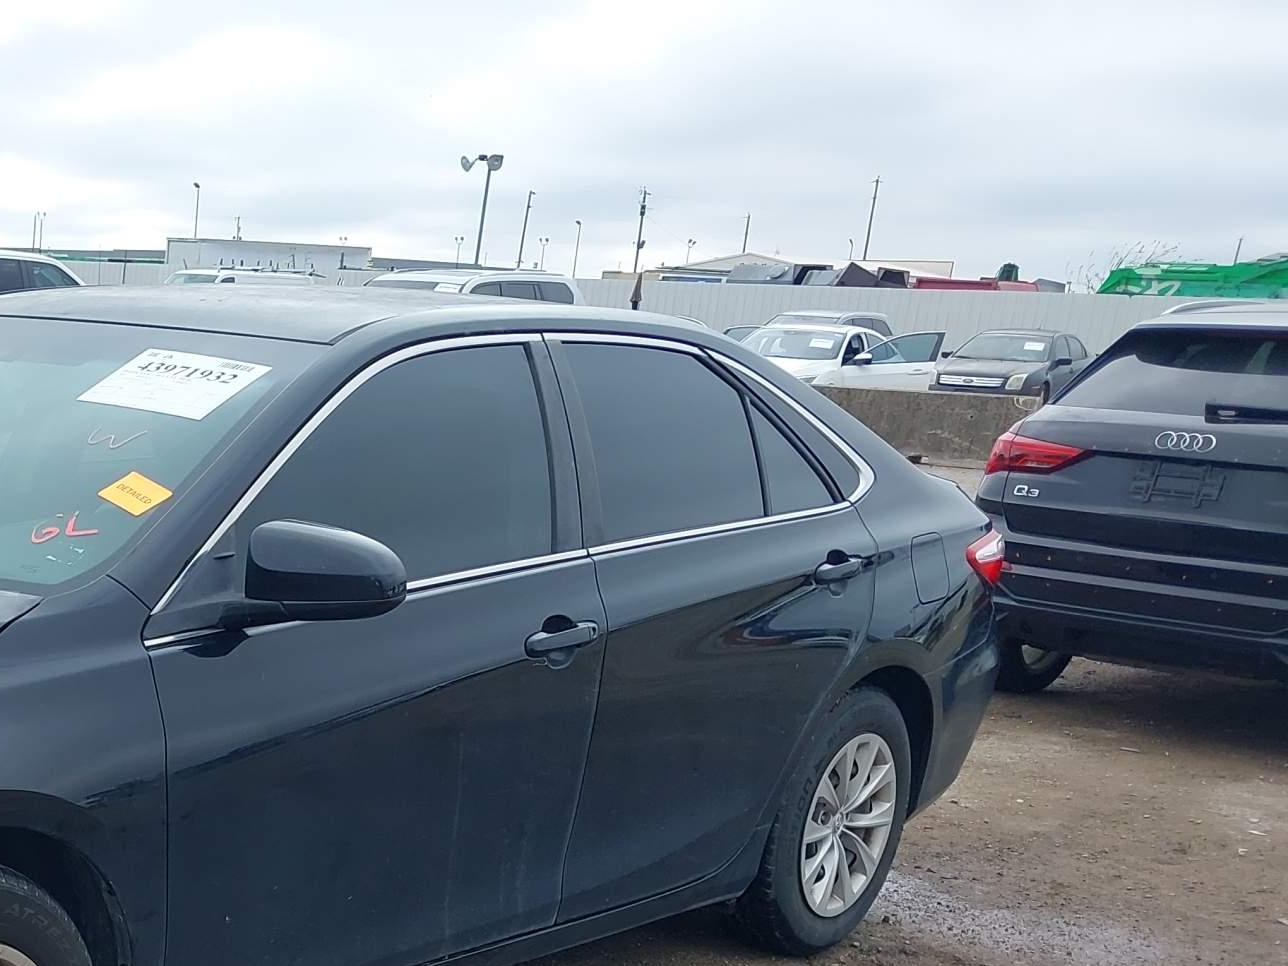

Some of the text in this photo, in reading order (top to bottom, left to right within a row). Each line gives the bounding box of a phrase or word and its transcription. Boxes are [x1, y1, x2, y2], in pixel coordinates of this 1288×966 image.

[137, 361, 239, 385] 43971932
[115, 483, 153, 506] DETAILED
[1013, 484, 1040, 498] Q3
